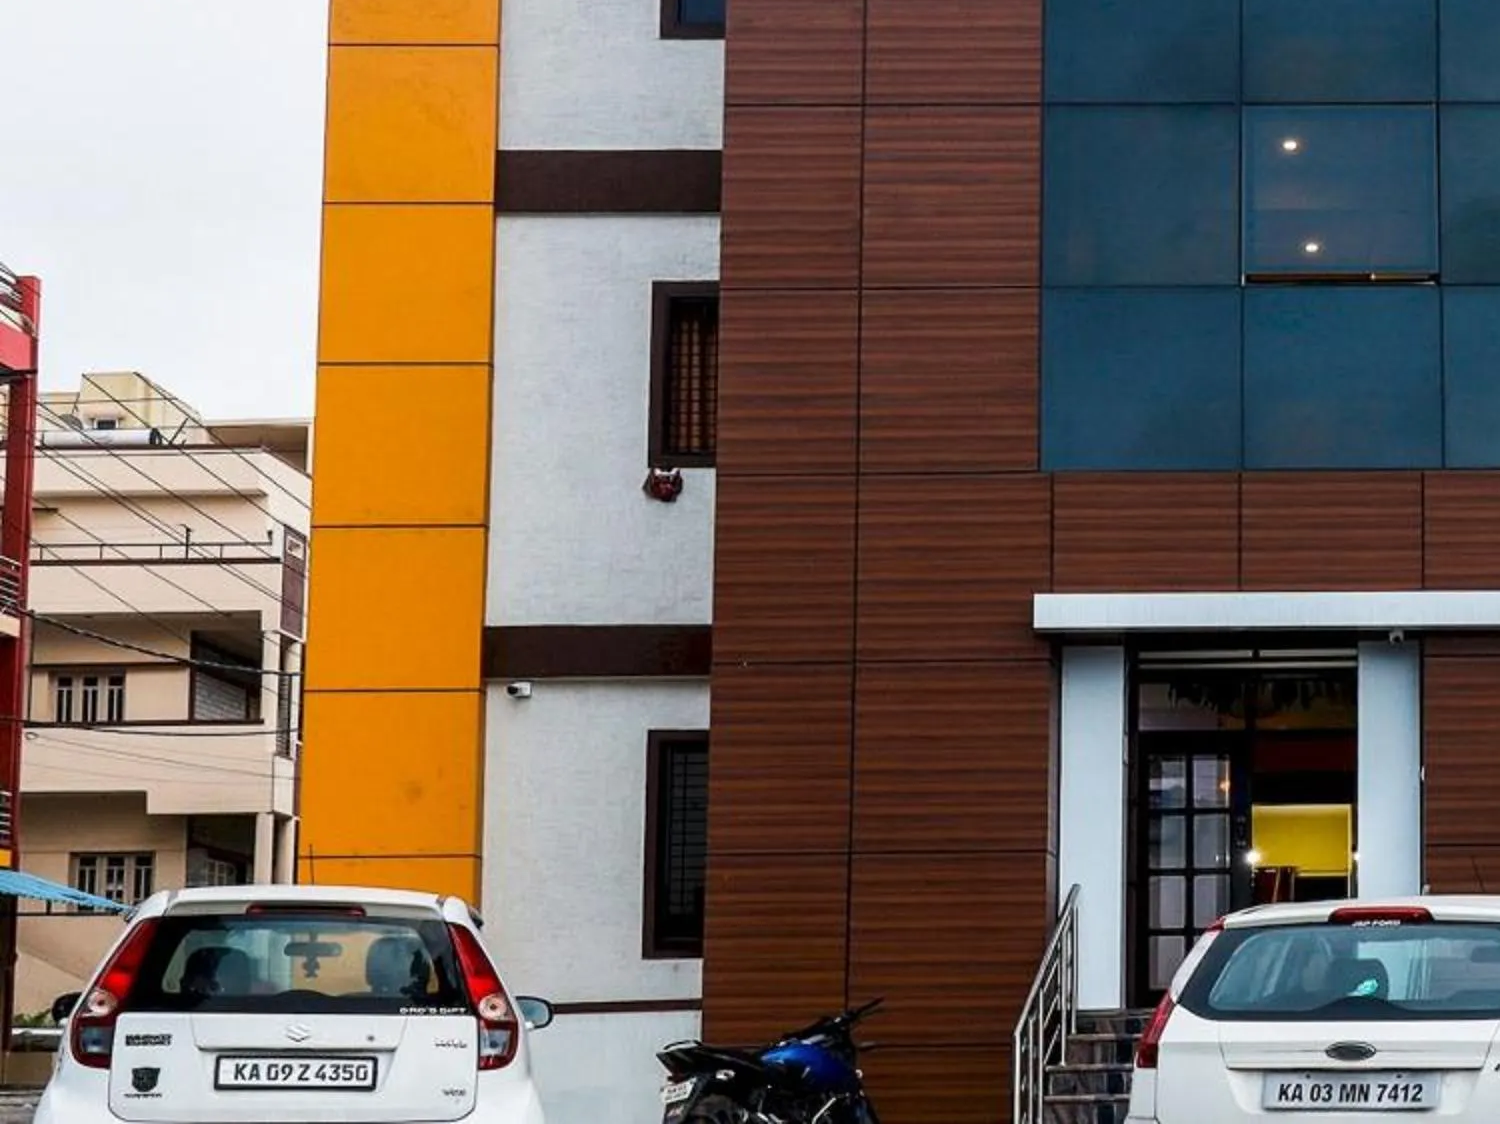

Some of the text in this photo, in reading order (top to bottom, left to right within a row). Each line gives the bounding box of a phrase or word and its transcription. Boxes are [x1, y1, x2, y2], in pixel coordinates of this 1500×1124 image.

[233, 1063, 369, 1082] KA 09 Z 4350
[1278, 1083, 1424, 1102] KA 03 MN 7412
